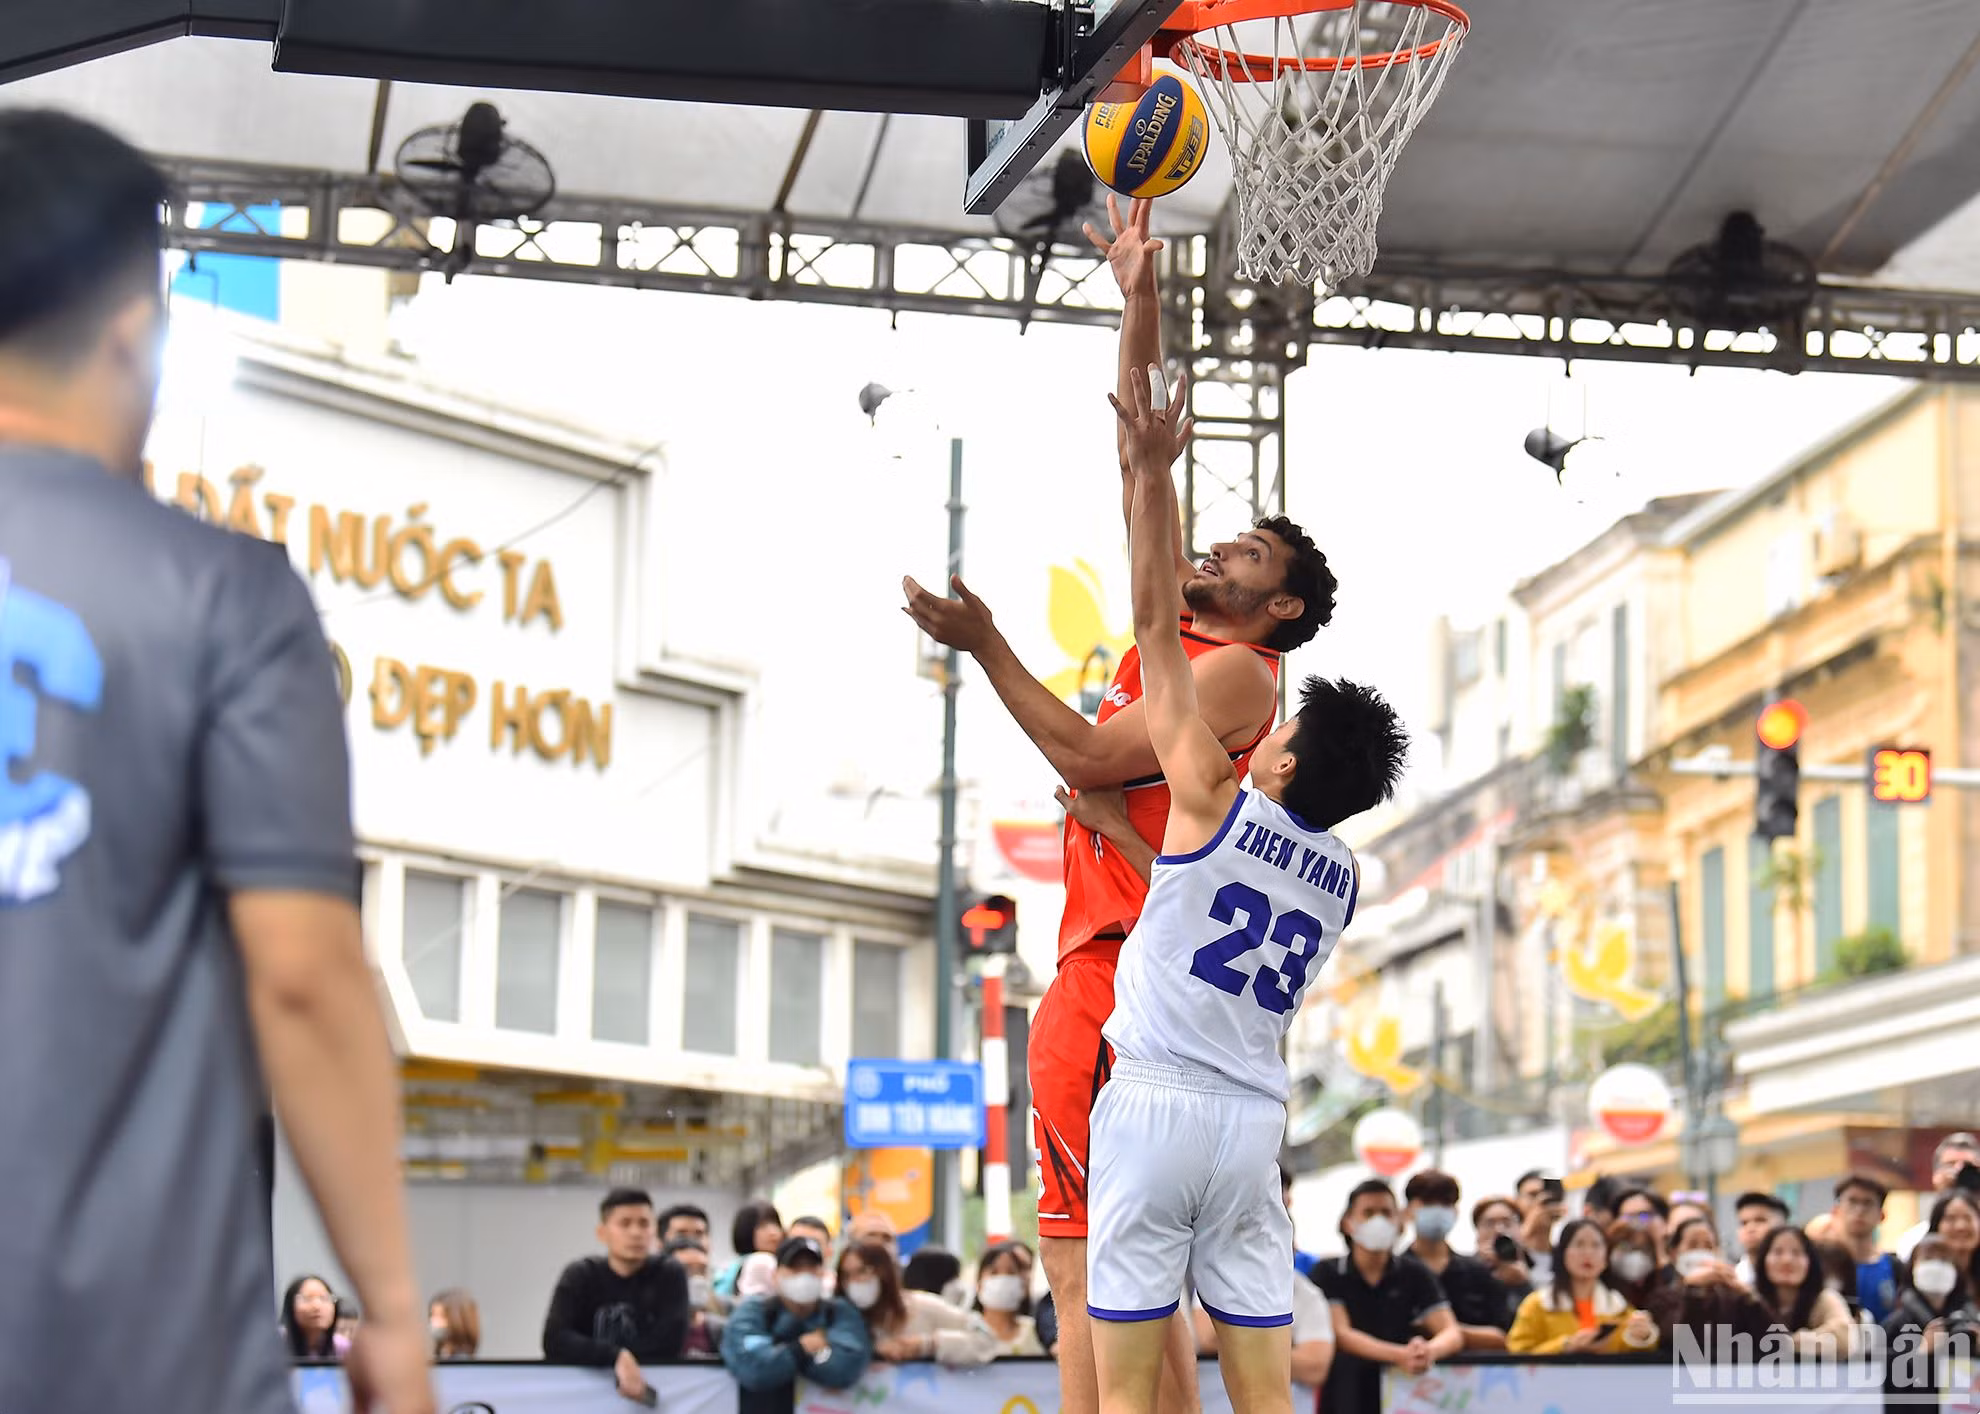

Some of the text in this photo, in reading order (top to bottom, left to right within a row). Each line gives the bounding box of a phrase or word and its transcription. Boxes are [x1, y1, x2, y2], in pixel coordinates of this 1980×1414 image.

[1127, 92, 1177, 174] SPALDING
[497, 547, 565, 639] TA
[368, 655, 477, 761] ĐẸP
[490, 680, 613, 776] HƠN
[1874, 749, 1931, 801] 30
[1234, 820, 1351, 899] ZHEN YANG
[1189, 881, 1323, 1015] 23
